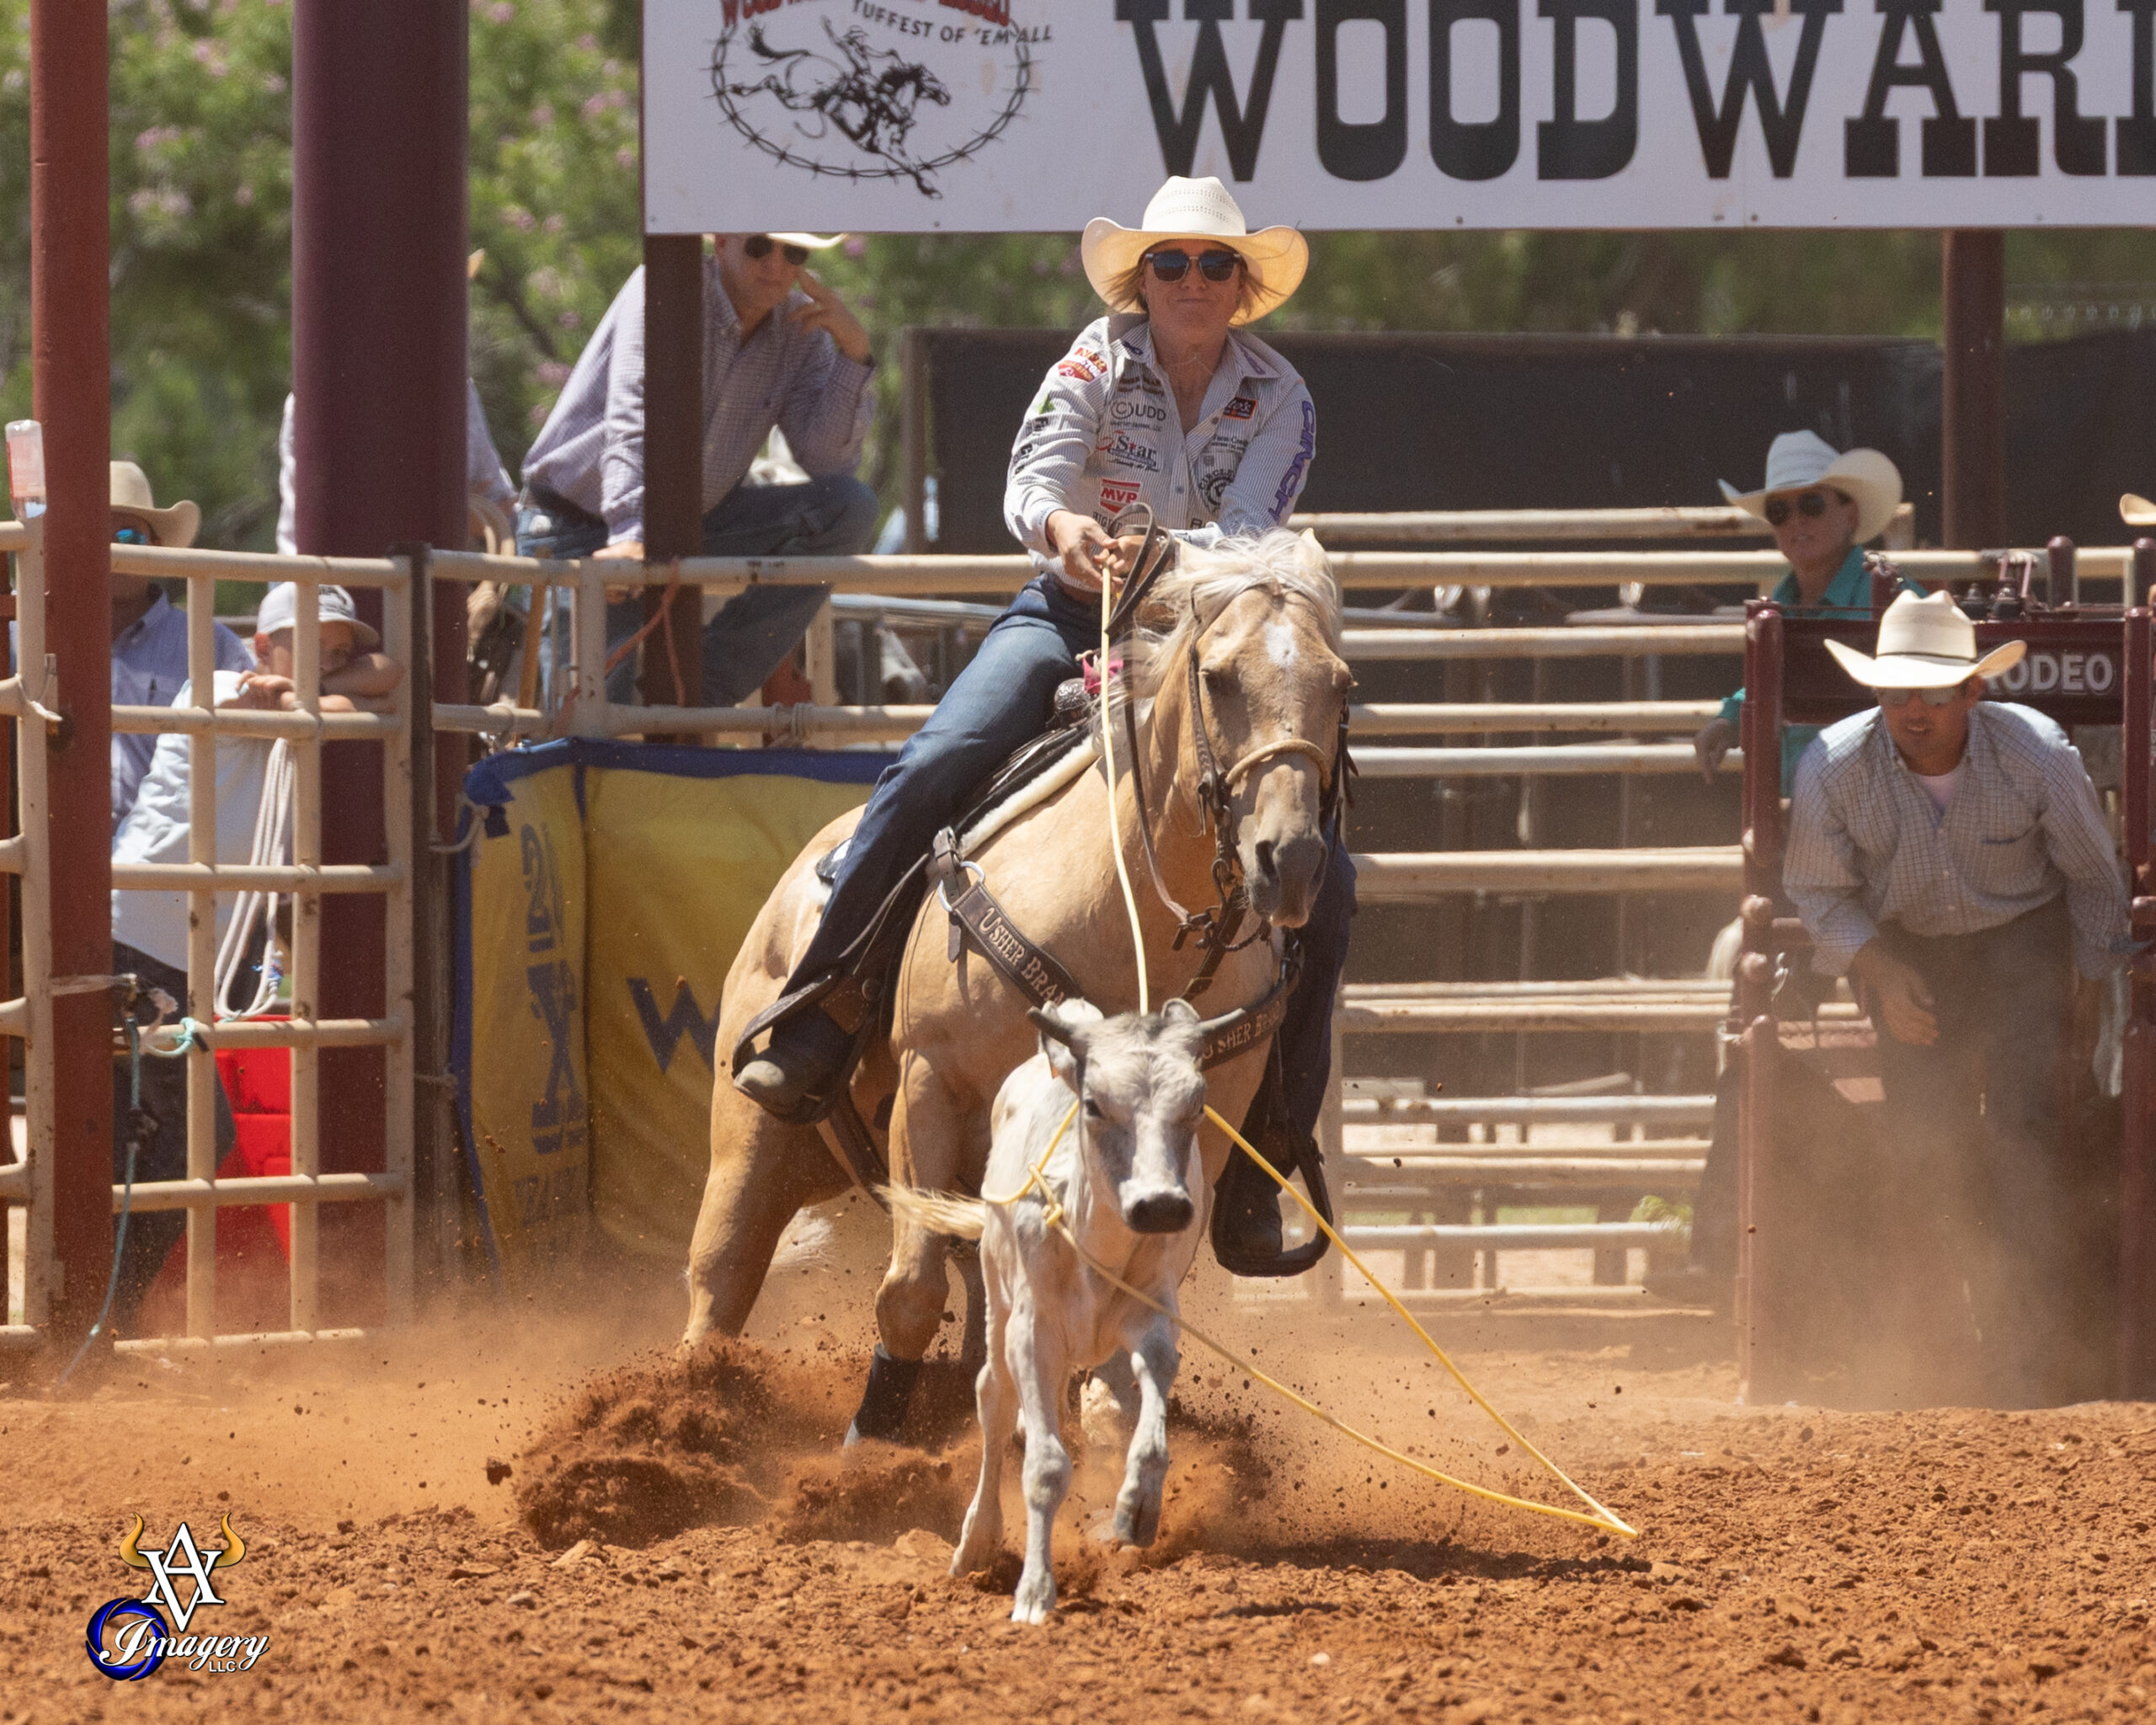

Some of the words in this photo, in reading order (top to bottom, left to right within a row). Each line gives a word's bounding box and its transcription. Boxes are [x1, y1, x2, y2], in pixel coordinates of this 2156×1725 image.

[852, 0, 932, 37] TUFFEST
[940, 26, 966, 42] OF
[974, 29, 1010, 45] 'EM
[1017, 24, 1052, 42] ALL
[1268, 400, 1315, 525] CINCH
[1100, 488, 1138, 504] MVP
[979, 907, 1025, 966] USHER
